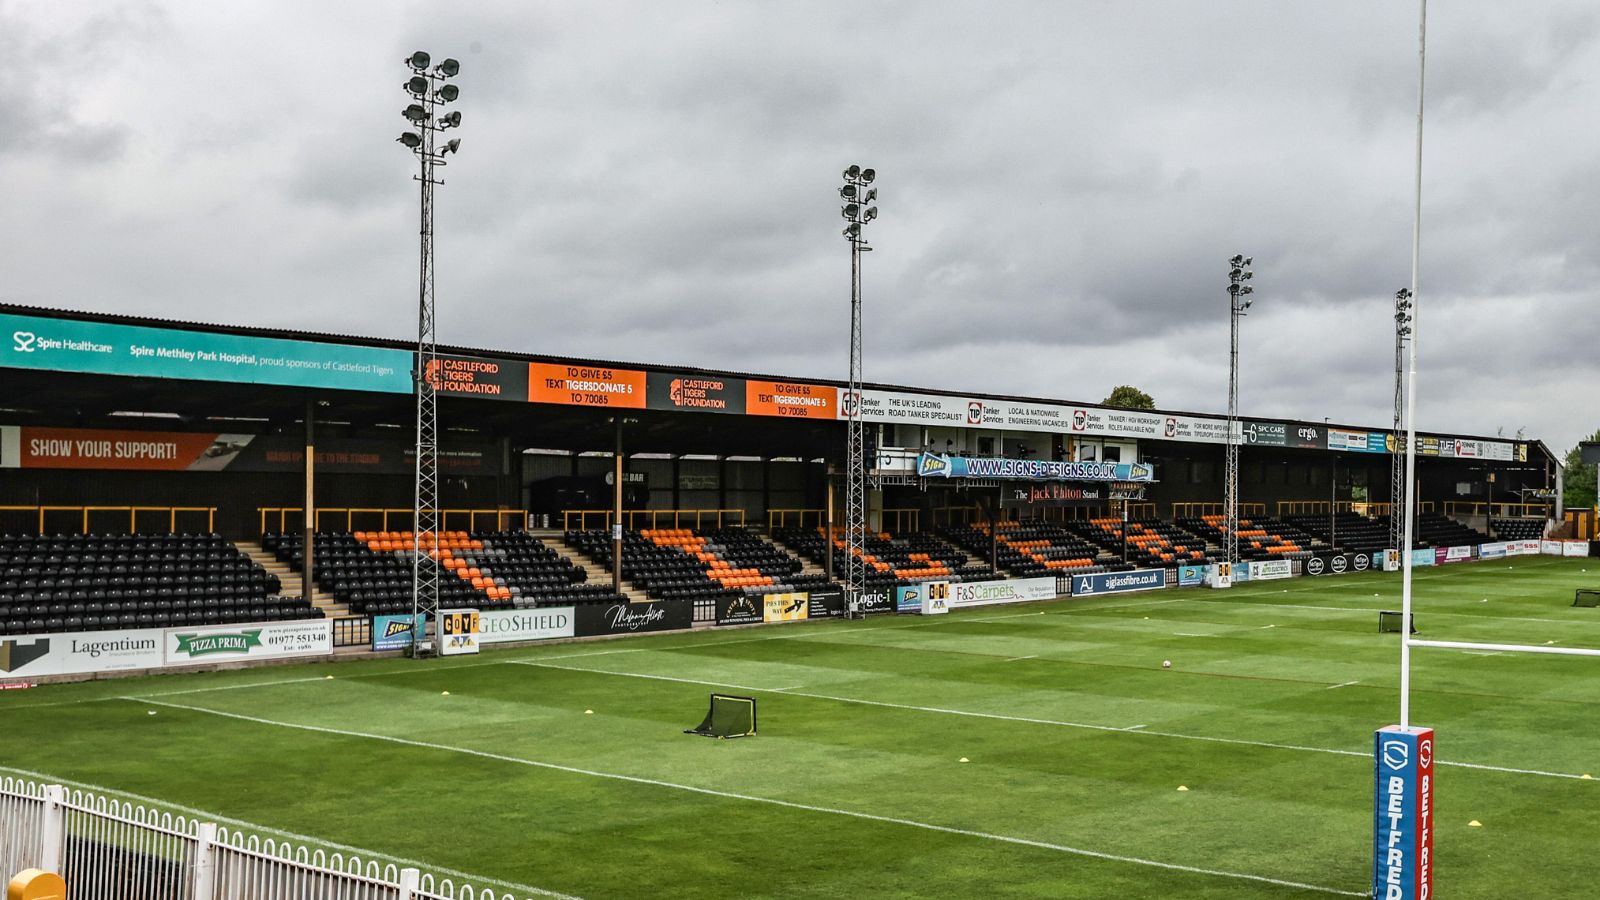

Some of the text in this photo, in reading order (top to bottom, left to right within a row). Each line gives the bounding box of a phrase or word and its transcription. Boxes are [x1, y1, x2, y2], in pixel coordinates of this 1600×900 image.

[37, 337, 112, 353] Spire Healthcare
[130, 345, 394, 376] Spire Methley Park Hospital, proud sponsors of Castleford Tigers
[444, 360, 498, 374] CASTLEFORD
[444, 371, 474, 382] TIGERS
[567, 368, 612, 380] TO GIVE £5
[444, 382, 500, 394] FOUNDATION
[545, 378, 632, 393] TEXT TIGERSDONATE 5
[684, 379, 724, 390] CASTLEFORD
[775, 384, 784, 393] TO
[785, 385, 801, 394] GIVE
[571, 393, 608, 404] TO 70085
[684, 389, 706, 398] TIGERS
[684, 398, 725, 409] FOUNDATION
[758, 394, 827, 407] TEXT TIGERSDONATE 5
[844, 400, 857, 410] TP
[860, 398, 880, 407] Tanker
[889, 399, 941, 409] THE UK'S LEADING
[778, 406, 807, 416] TO 70085
[860, 406, 885, 416] Services
[889, 409, 962, 421] ROAD TANKER SPECIALIST
[970, 409, 980, 419] TIP
[983, 406, 1000, 415] Tanker
[1031, 409, 1059, 418] NATIONWIDE
[983, 415, 1004, 424] Services
[1008, 417, 1068, 428] ENGINEERING VACANCIES
[1075, 416, 1084, 426] TIP
[1086, 414, 1100, 422] Tanker
[1123, 425, 1145, 433] AVAILABLE
[1166, 424, 1175, 432] TIP
[1270, 426, 1285, 434] CARS
[31, 439, 177, 459] SHOW YOUR SUPPORT!
[966, 458, 1116, 478] WWW.SIGNS-DESIGNS.CO.UK
[630, 473, 644, 482] BAR
[1015, 490, 1028, 500] The
[1028, 485, 1051, 504] Jack
[1082, 490, 1099, 499] Stand
[1080, 577, 1094, 590] AJ
[1105, 574, 1157, 589] ajglassfibre.co.uk
[956, 584, 1014, 600] F&S Carpets
[853, 589, 890, 607] Logic-i
[445, 616, 478, 632] COYF
[190, 637, 247, 652] PIZZA PRIMA
[268, 633, 326, 645] 01977 551340
[71, 637, 155, 657] Lagentium
[1386, 776, 1404, 900] BETFRED
[1420, 775, 1429, 900] BETFRED
